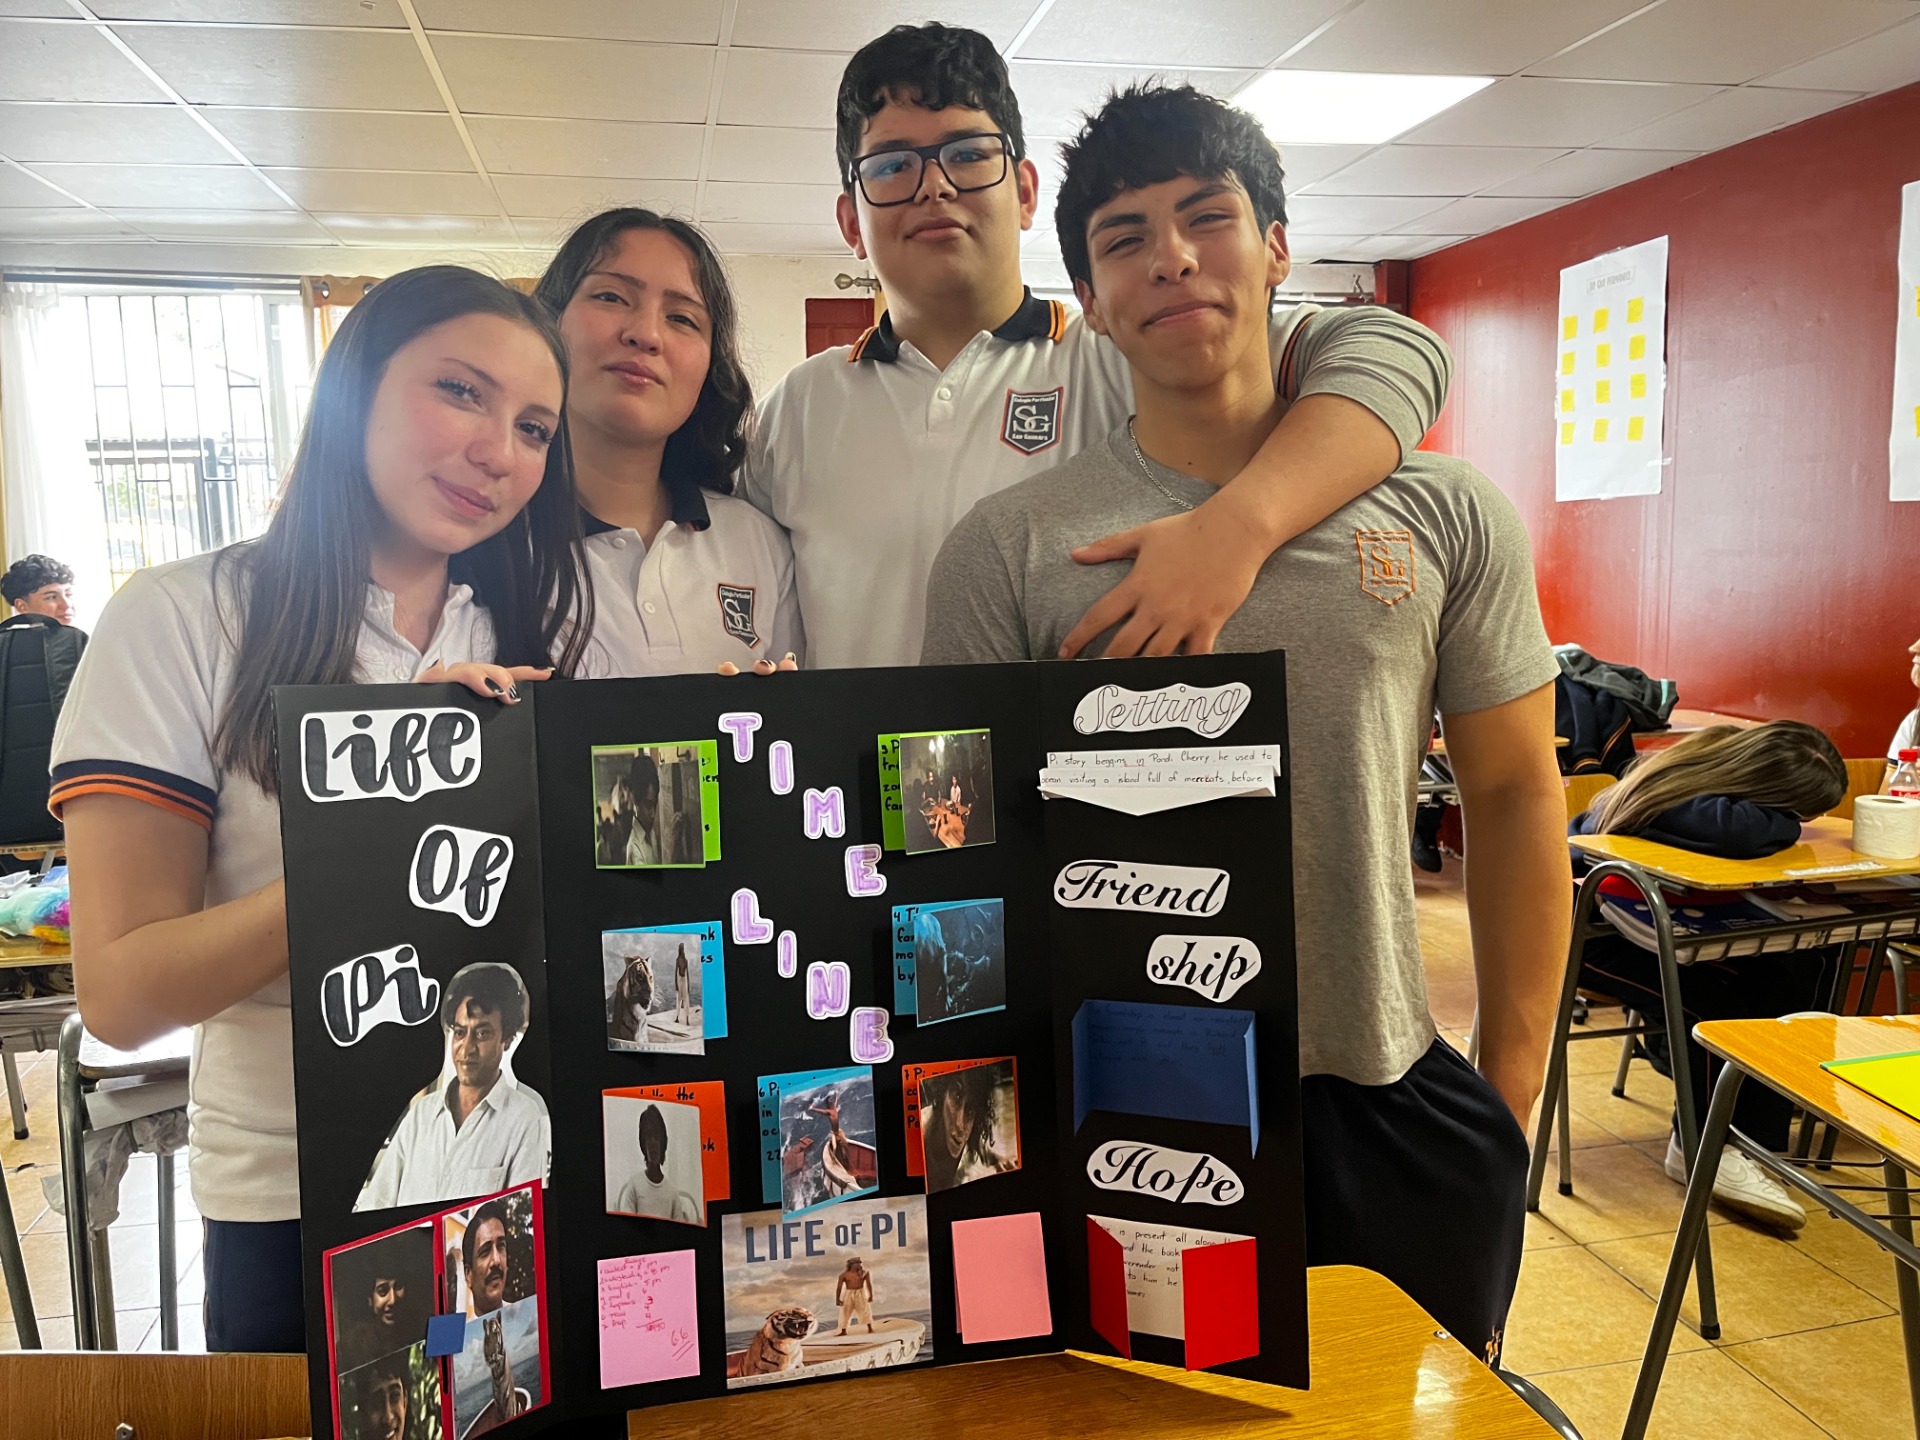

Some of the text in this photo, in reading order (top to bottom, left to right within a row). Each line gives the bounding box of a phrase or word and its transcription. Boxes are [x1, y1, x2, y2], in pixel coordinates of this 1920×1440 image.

[1013, 405, 1052, 432] SG
[1075, 685, 1248, 735] Setting
[305, 712, 476, 798] Life
[1064, 753, 1086, 768] story
[1218, 750, 1229, 761] he
[1235, 750, 1255, 761] used
[1262, 749, 1272, 760] to
[1069, 772, 1096, 787] visiting
[1147, 771, 1161, 783] full
[1168, 770, 1179, 782] of
[1231, 770, 1263, 782] before
[416, 829, 509, 921] Of
[1058, 861, 1227, 913] Friend
[1152, 940, 1256, 999] ship
[676, 1086, 694, 1100] the
[762, 1105, 772, 1117] in
[1093, 1146, 1238, 1203] Hope
[745, 1220, 825, 1263] LIFE
[871, 1211, 907, 1249] PI
[1135, 1230, 1166, 1240] present
[1175, 1232, 1187, 1243] all
[1142, 1242, 1154, 1254] the
[1161, 1247, 1180, 1257] book
[1127, 1269, 1137, 1280] to
[1167, 1276, 1178, 1287] he
[1166, 1263, 1179, 1272] not
